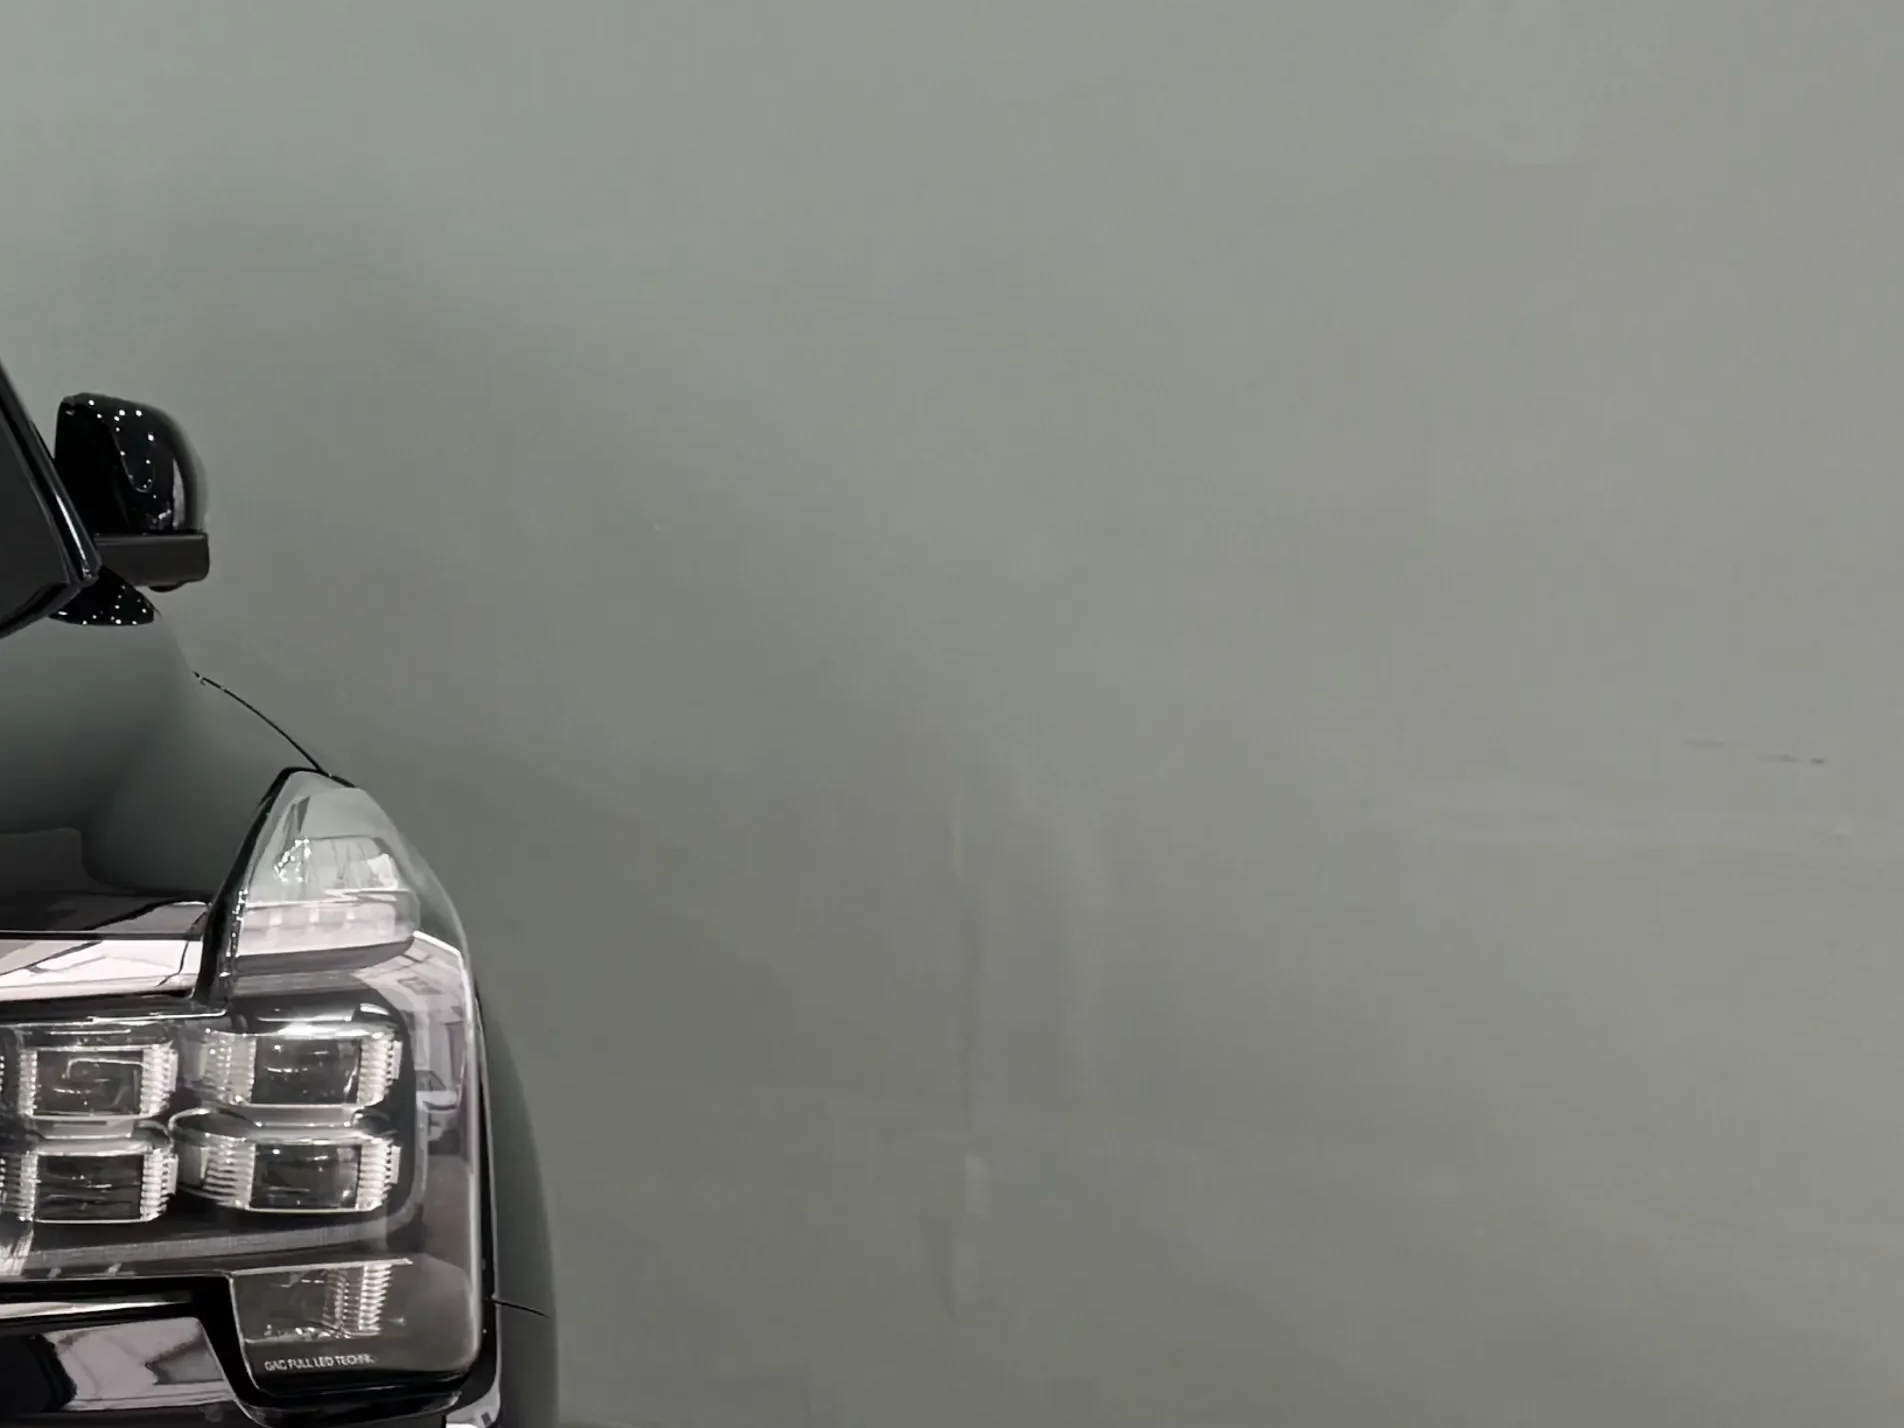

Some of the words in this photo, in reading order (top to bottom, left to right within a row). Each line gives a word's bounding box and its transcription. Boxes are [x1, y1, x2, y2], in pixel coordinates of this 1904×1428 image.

[264, 1359, 288, 1371] GAC
[287, 1357, 313, 1370] FULL
[313, 1355, 334, 1368] LED
